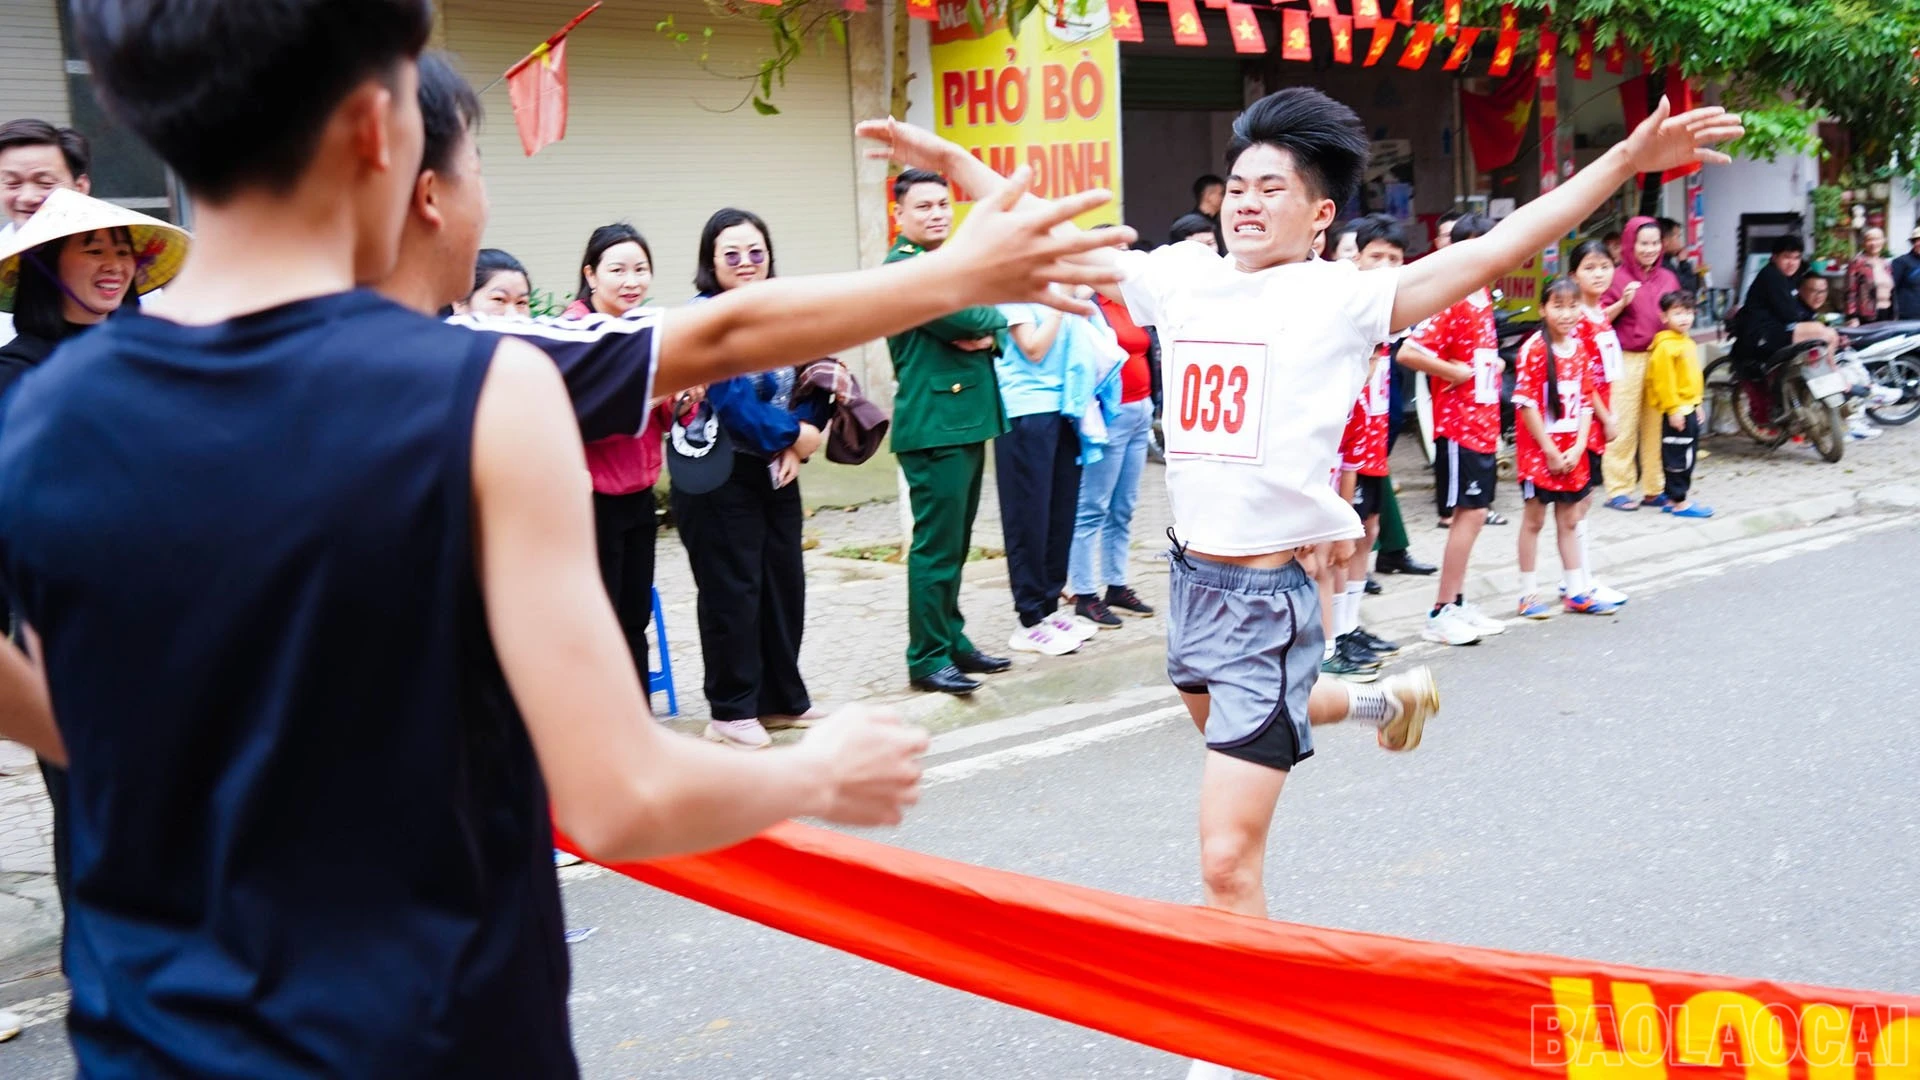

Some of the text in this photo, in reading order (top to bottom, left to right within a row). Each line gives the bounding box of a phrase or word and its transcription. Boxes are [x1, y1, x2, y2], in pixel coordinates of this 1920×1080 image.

[942, 48, 1105, 126] PHỞ BÒ
[1180, 363, 1249, 434] 033
